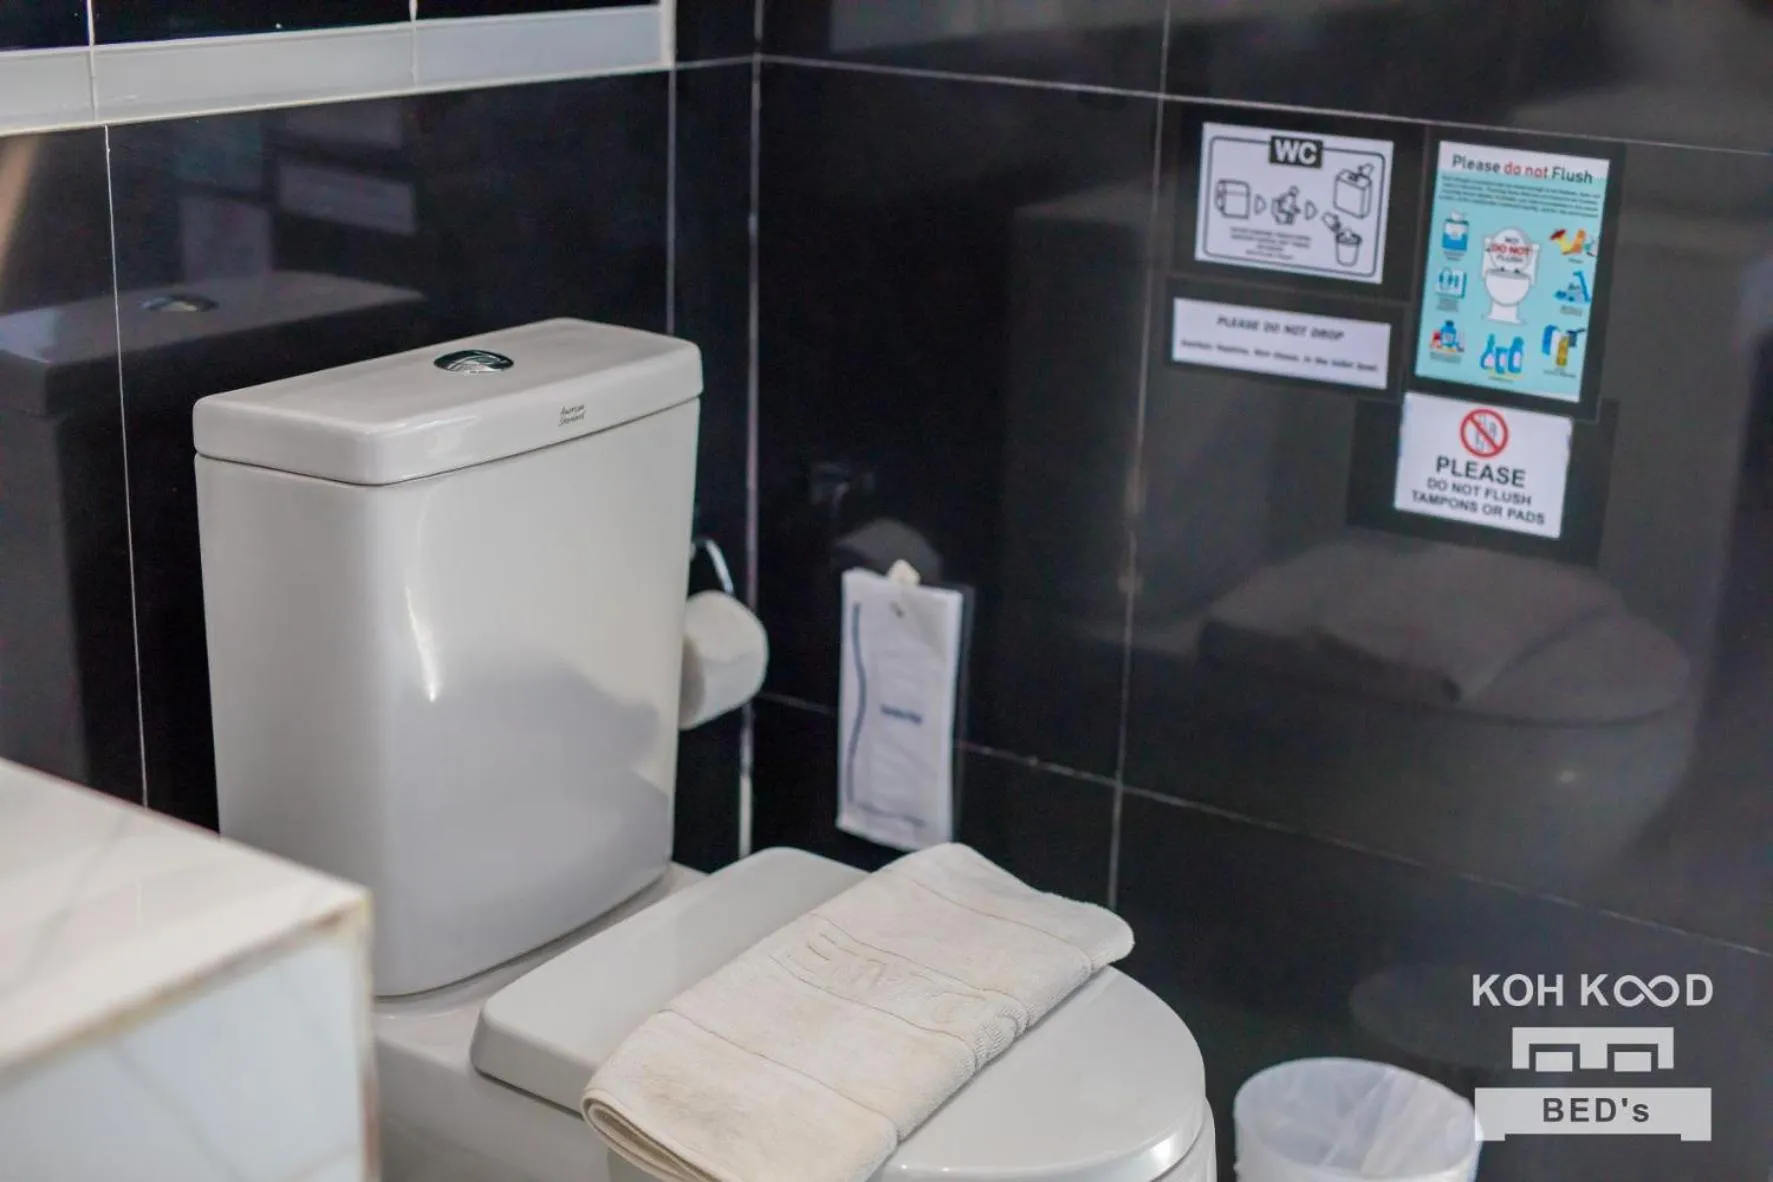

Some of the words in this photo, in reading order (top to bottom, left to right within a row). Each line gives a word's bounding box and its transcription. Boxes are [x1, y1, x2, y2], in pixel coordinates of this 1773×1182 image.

[1273, 138, 1318, 166] WC
[1452, 154, 1501, 174] Please
[1503, 161, 1521, 176] do
[1524, 165, 1549, 179] not
[1551, 166, 1594, 185] Flush
[1216, 314, 1259, 332] PLEASE
[1263, 320, 1279, 335] DO
[1282, 323, 1307, 338] NOT
[1310, 327, 1345, 342] DROP
[1435, 455, 1527, 488] PLEASE
[1426, 478, 1448, 492] DO
[1451, 481, 1482, 498] NOT
[1484, 486, 1532, 507] FLUSH
[1413, 491, 1478, 513] TAMPONS
[1482, 503, 1503, 518] OR
[1508, 509, 1545, 526] PADS
